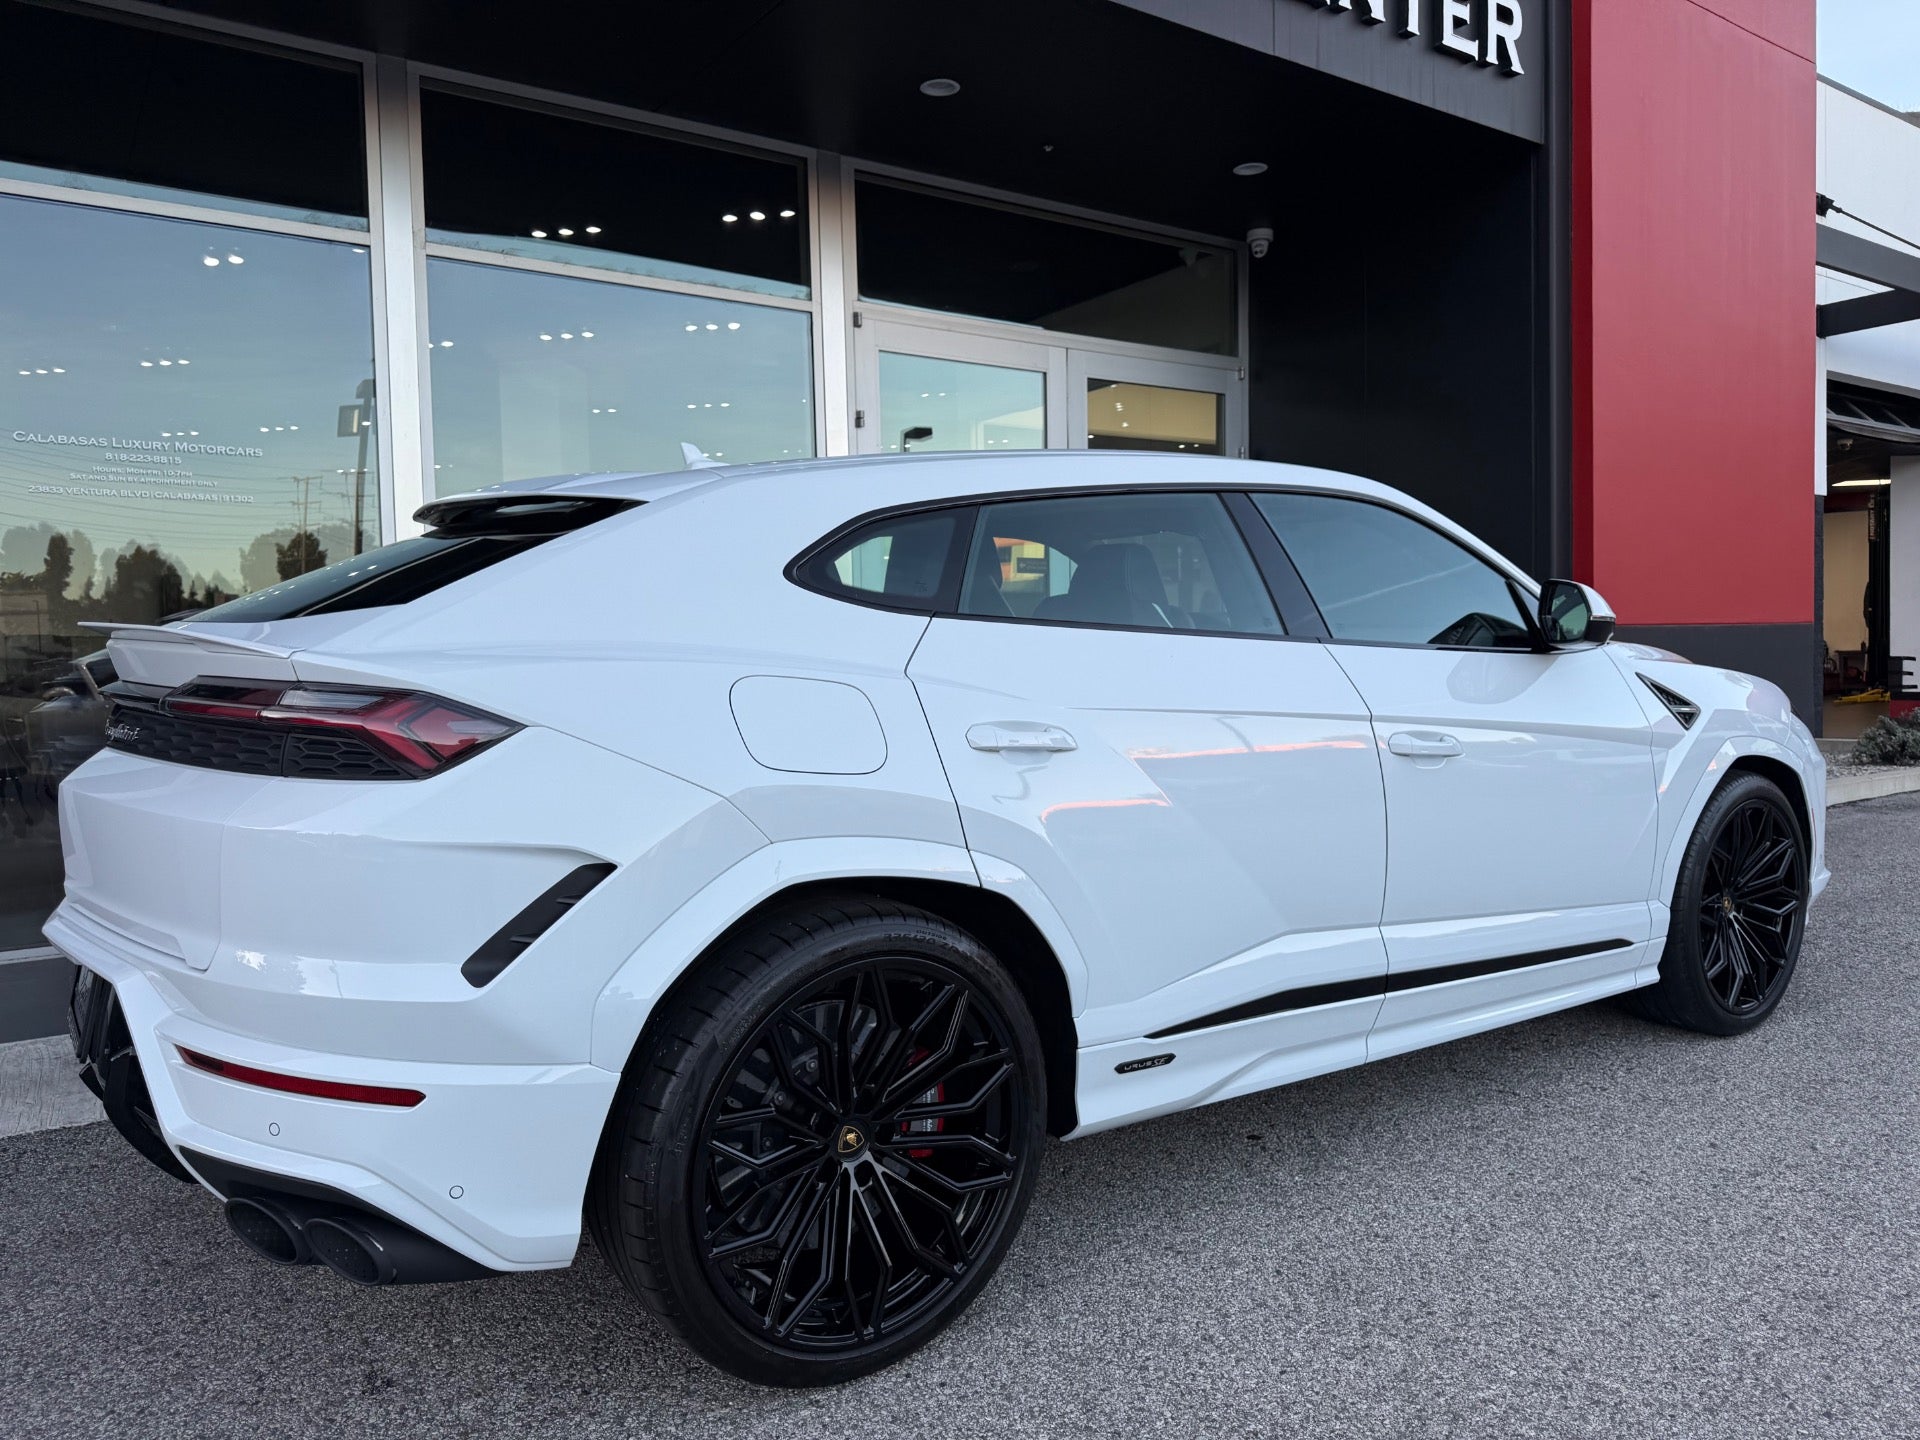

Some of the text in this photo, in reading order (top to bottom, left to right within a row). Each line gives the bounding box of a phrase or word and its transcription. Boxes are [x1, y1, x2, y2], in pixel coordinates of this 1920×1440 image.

[13, 431, 263, 457] CALABASAS LUXURY MOTORCARS
[105, 453, 182, 464] 818-223-8815
[65, 487, 118, 497] VENTURA
[1124, 1061, 1152, 1071] URUS
